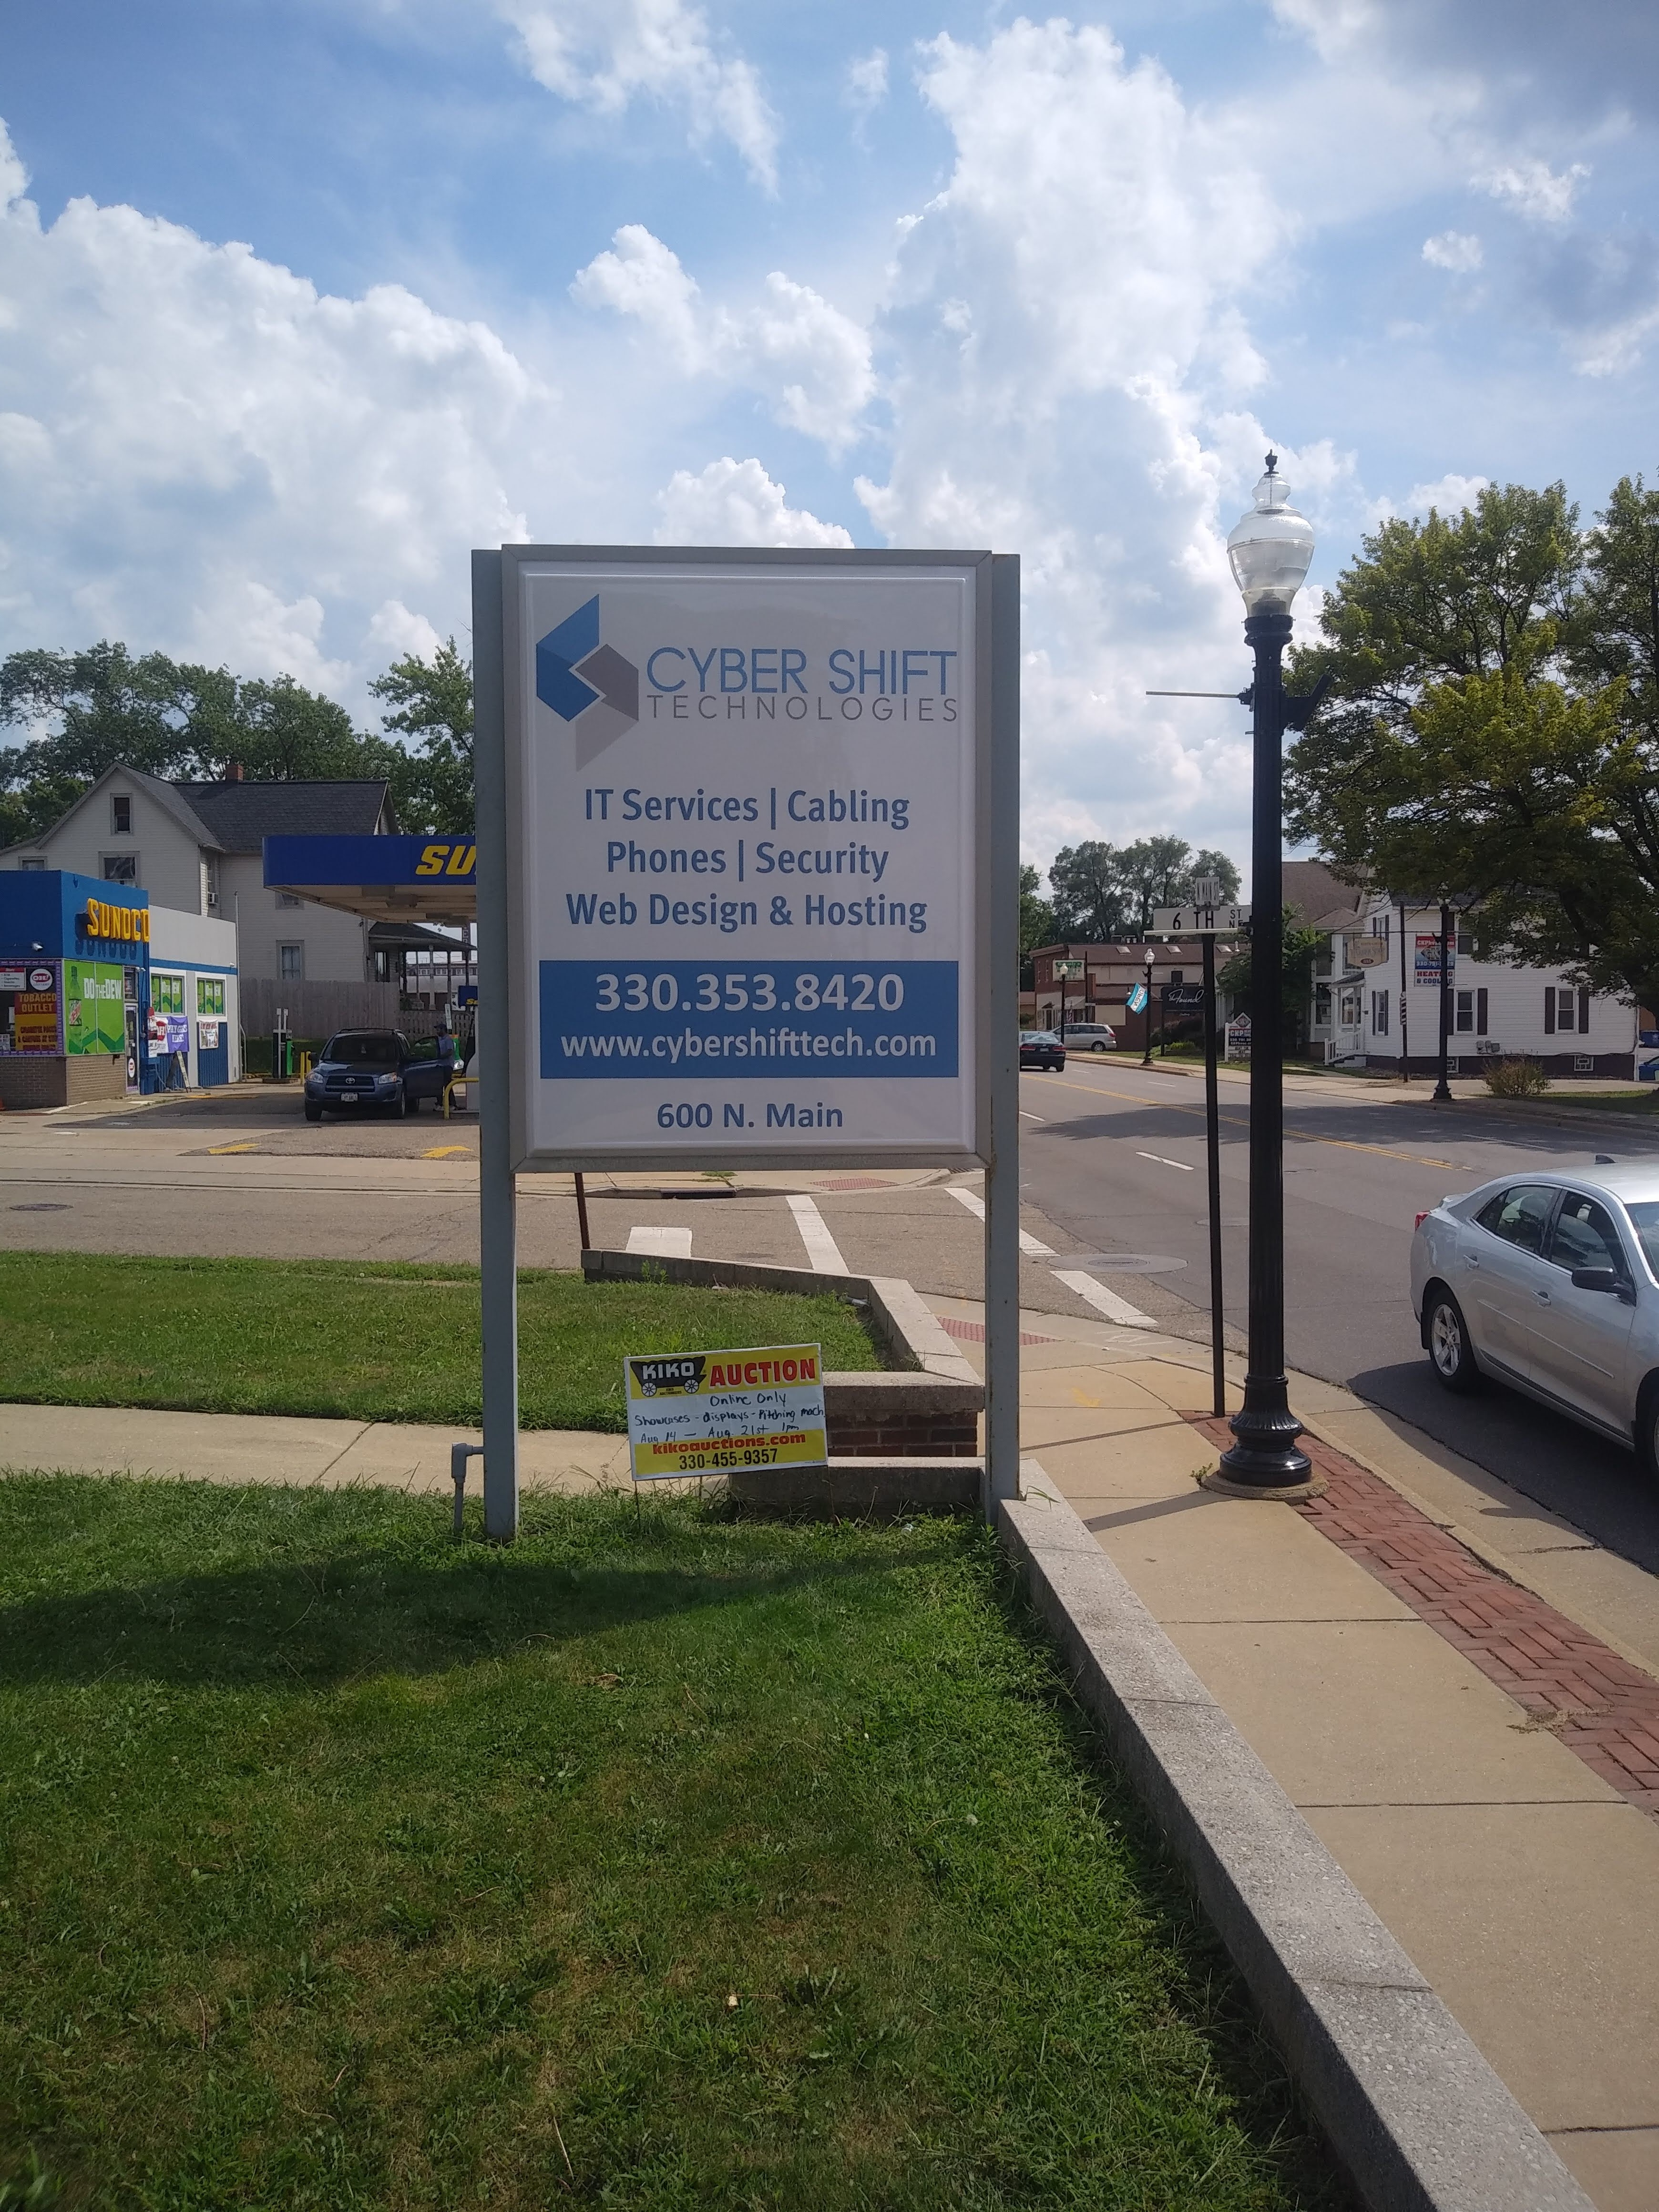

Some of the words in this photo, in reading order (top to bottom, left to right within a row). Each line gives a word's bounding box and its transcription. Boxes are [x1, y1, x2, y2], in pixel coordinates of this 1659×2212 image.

[647, 647, 808, 694] CYBER
[829, 649, 957, 695] SHIFT
[647, 696, 958, 722] TECHNOLOGIES
[586, 789, 614, 820] IT
[622, 789, 758, 821] Services
[788, 789, 910, 830] Cabling
[416, 845, 476, 874] SU
[608, 840, 727, 873] Phones
[756, 841, 889, 883] Security
[87, 898, 149, 942] SUNOCO
[565, 892, 637, 925] Web
[650, 893, 757, 933] Design
[769, 896, 794, 925] &
[806, 893, 928, 933] Hosting
[1230, 909, 1242, 919] ST
[19, 993, 57, 1003] TOBACCO
[83, 978, 95, 999] DO
[104, 978, 122, 1000] DEW
[596, 973, 904, 1011] 330.353.8420
[21, 1003, 53, 1012] OUTLET
[561, 1027, 936, 1064] www.cybershifttech.com
[657, 1103, 713, 1128] 600
[724, 1103, 754, 1128] N.
[767, 1102, 842, 1127] Main
[643, 1362, 695, 1380] KIKO
[710, 1359, 816, 1387] AUCTION
[710, 1394, 751, 1407] Online
[757, 1391, 786, 1407] Only
[635, 1414, 691, 1426] Showcases
[666, 1431, 676, 1442] 14
[741, 1424, 769, 1435] 21st
[653, 1434, 806, 1454] kikoauctions.com
[679, 1448, 778, 1470] 330-455-9357
